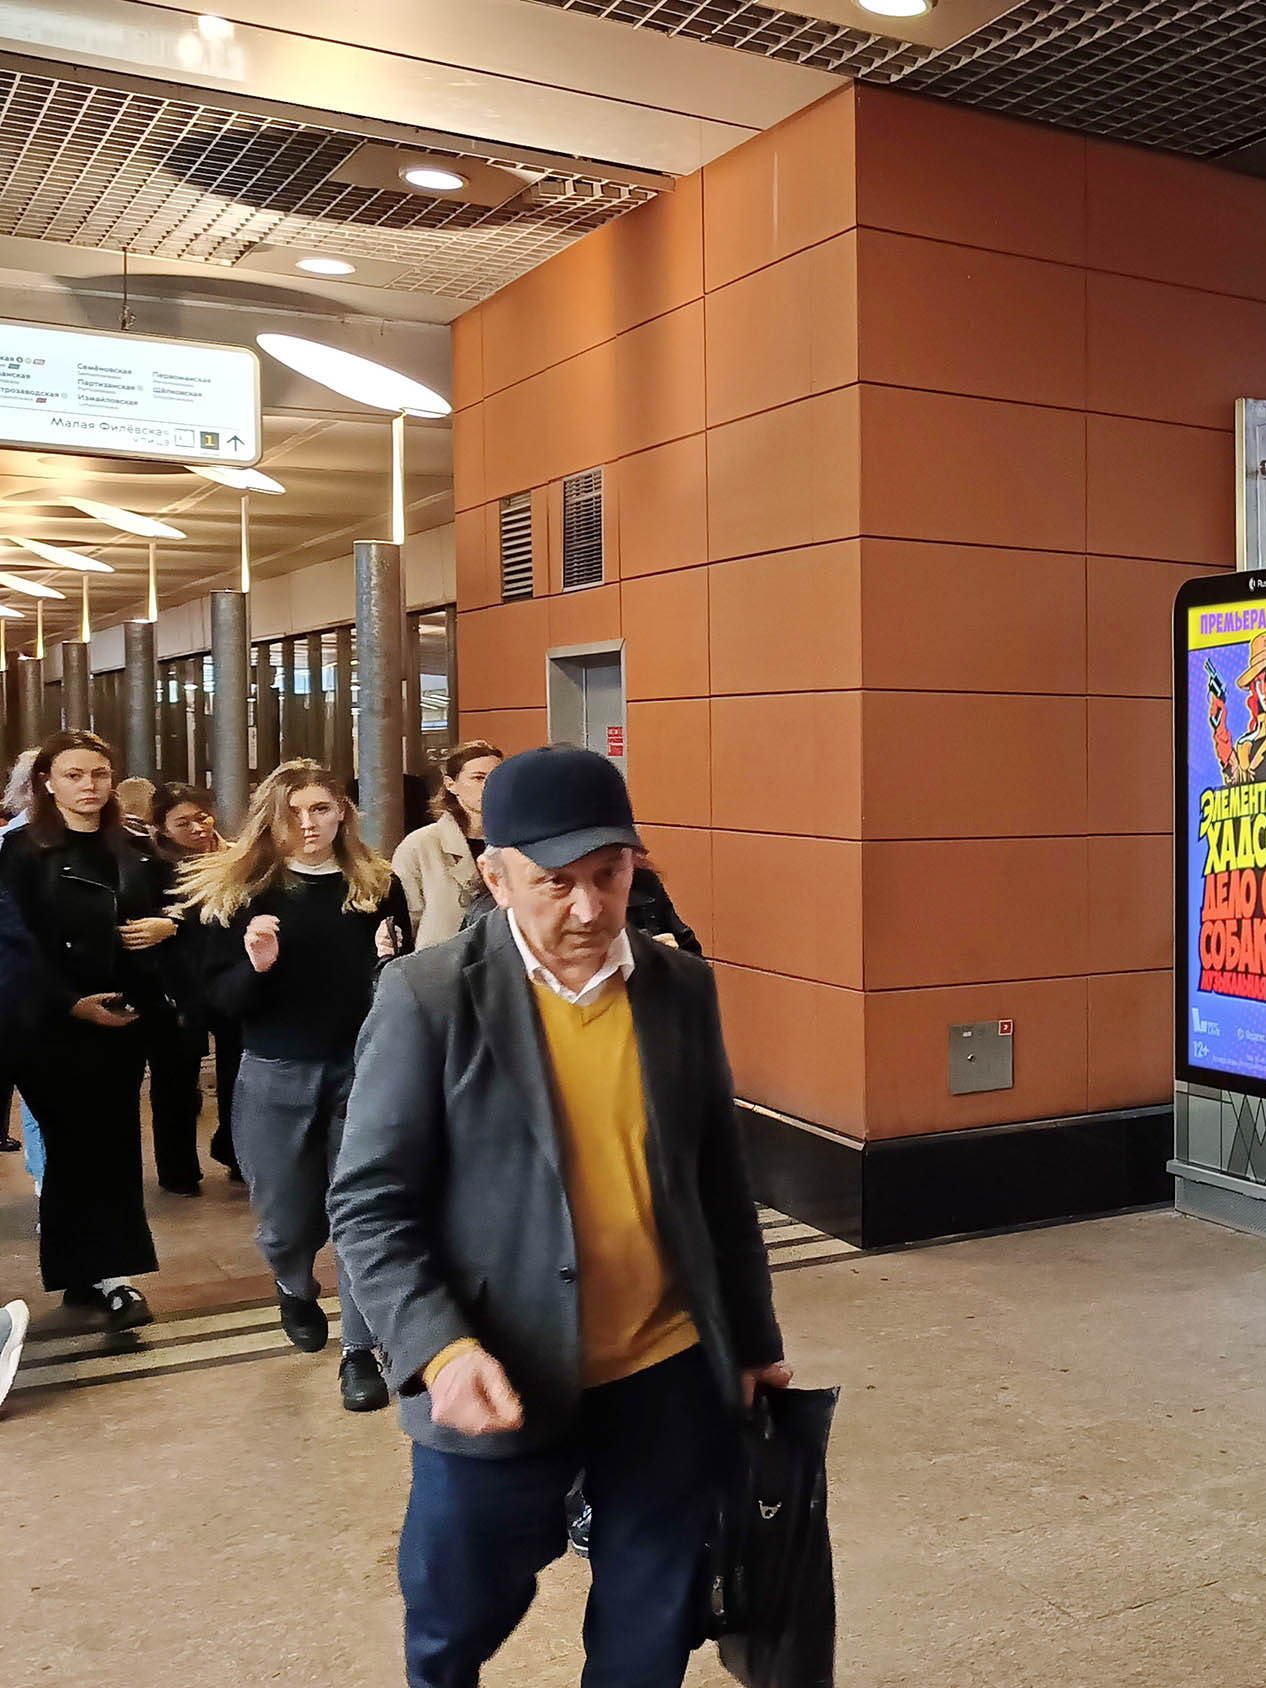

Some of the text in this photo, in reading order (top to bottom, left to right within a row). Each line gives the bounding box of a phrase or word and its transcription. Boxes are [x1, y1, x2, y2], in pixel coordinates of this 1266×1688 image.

[51, 417, 95, 429] Малая
[204, 434, 216, 447] 1
[1200, 611, 1266, 635] ПРЕМЬЕРА
[1202, 868, 1257, 922] ДЕЛО
[1193, 1040, 1210, 1058] 12+
